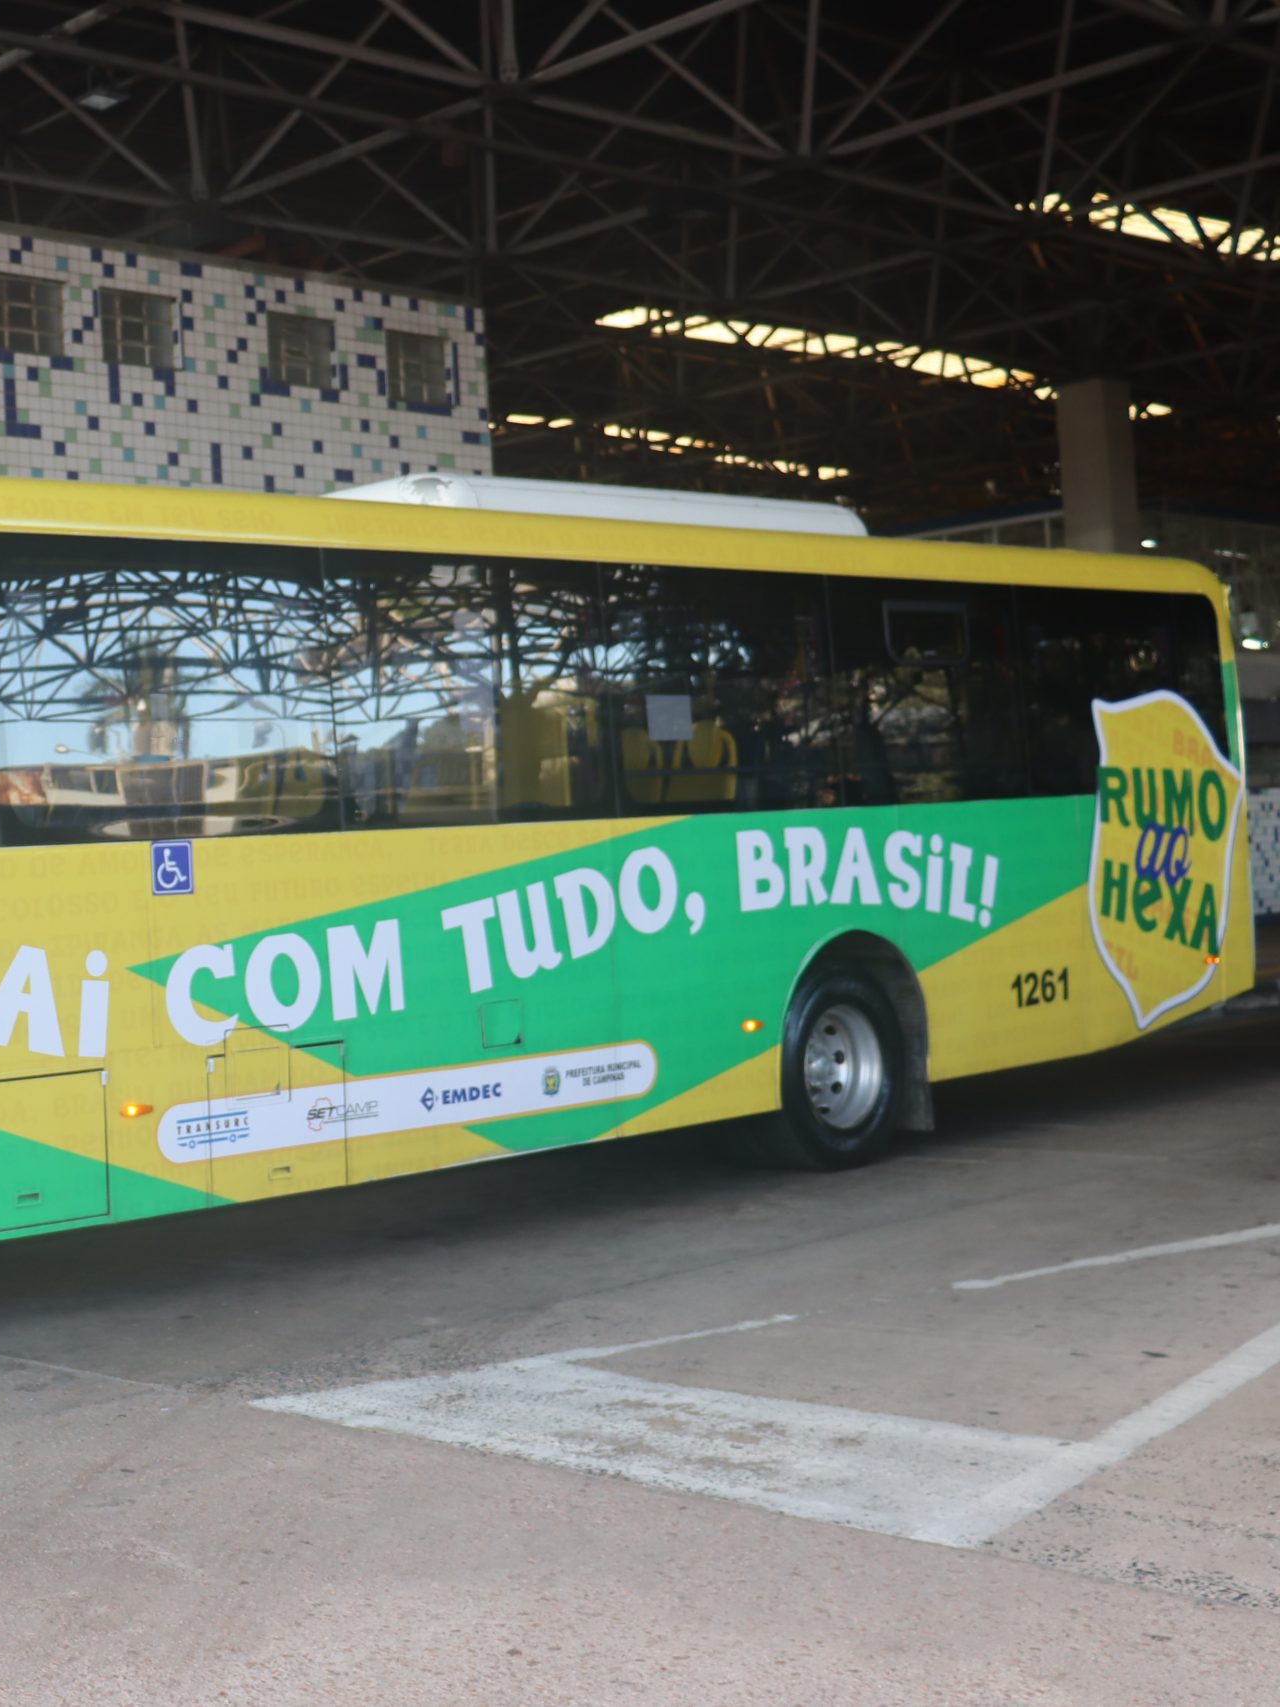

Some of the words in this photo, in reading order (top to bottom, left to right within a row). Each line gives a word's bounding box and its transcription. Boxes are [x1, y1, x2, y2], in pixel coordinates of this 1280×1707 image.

[1097, 767, 1227, 841] RUMO
[1100, 859, 1220, 956] HeXA
[165, 918, 406, 1047] COM
[441, 846, 705, 993] TUDO,
[735, 826, 999, 928] BRASiL!
[1011, 967, 1069, 1008] 1261
[565, 1063, 606, 1079] PREFEITURA
[607, 1059, 642, 1074] MUNICIPAL
[582, 1077, 592, 1087] DE
[593, 1072, 625, 1085] CAMPINAS
[442, 1082, 502, 1105] EMDEC
[306, 1100, 379, 1121] SETCAMP
[176, 1115, 250, 1136] TRANSURC
